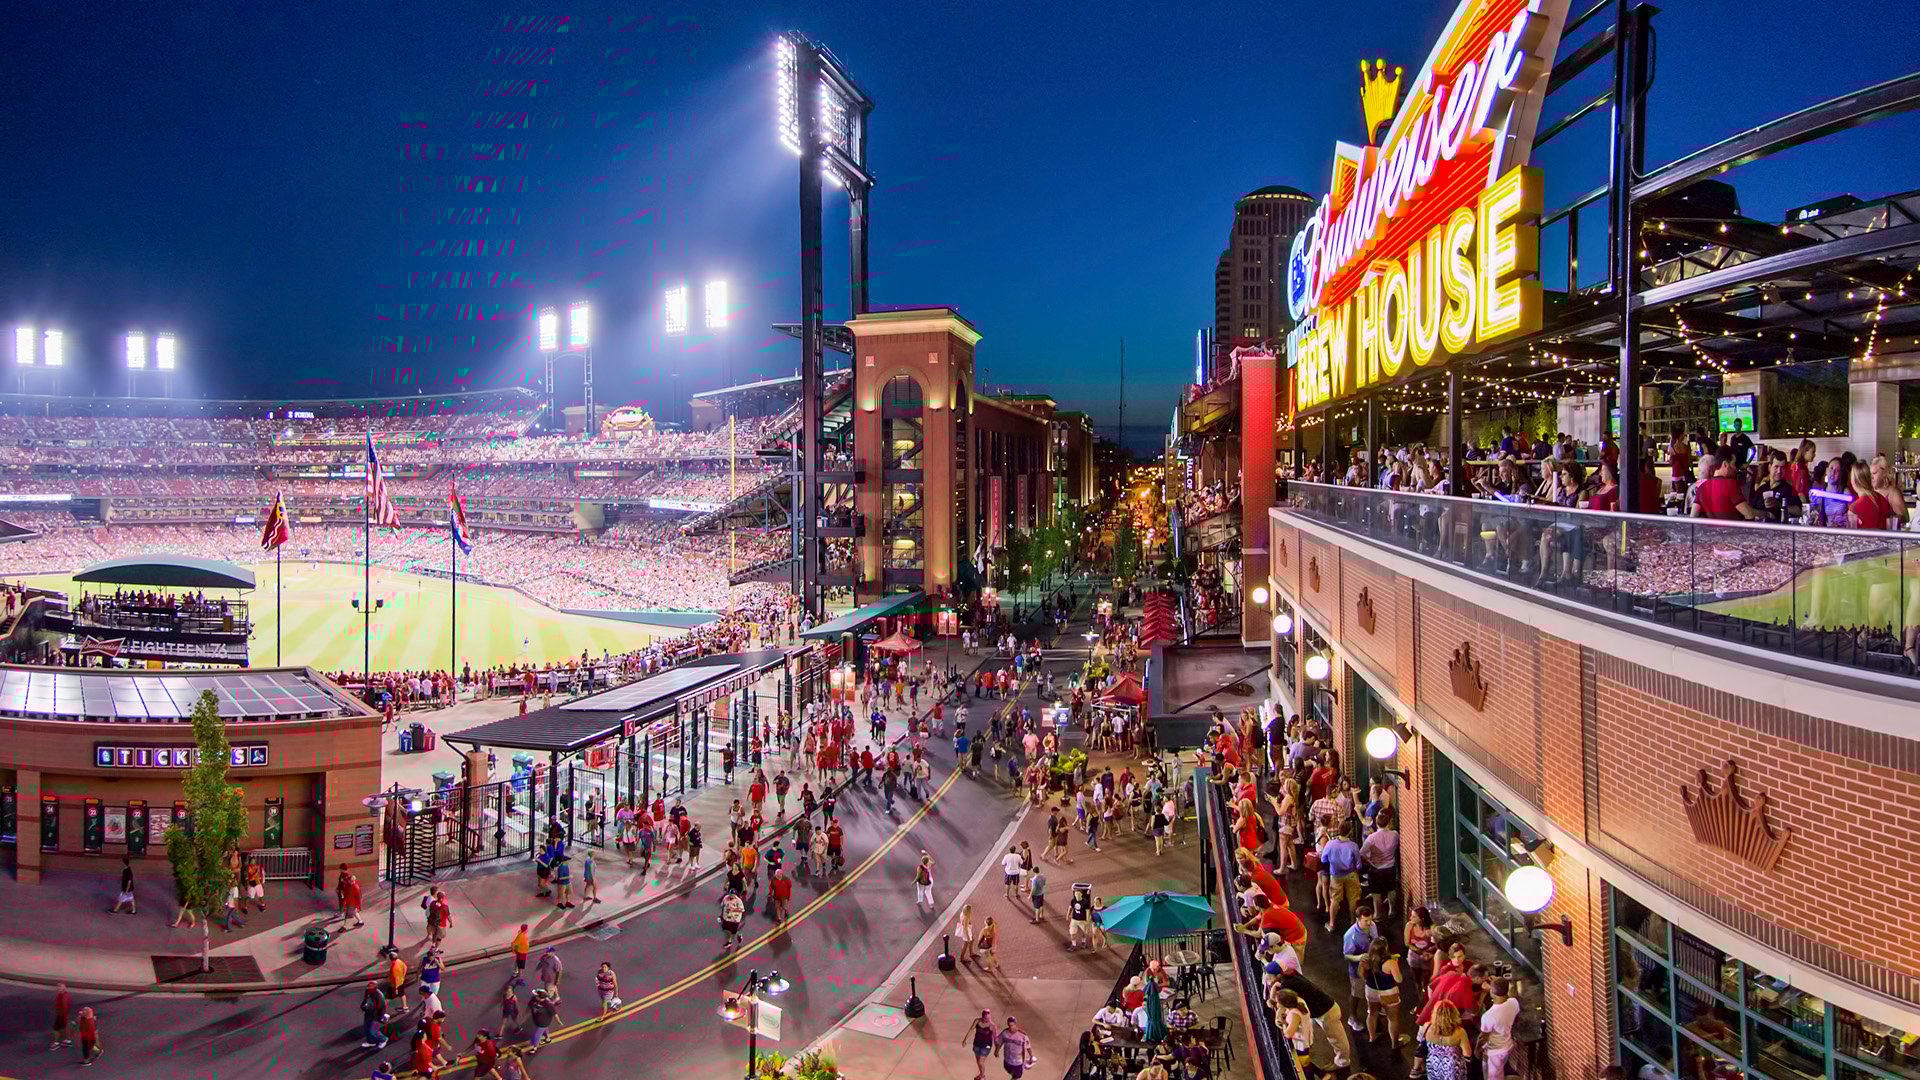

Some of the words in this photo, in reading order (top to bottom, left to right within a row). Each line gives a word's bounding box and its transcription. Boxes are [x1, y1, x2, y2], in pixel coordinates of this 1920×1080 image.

[1302, 9, 1533, 316] Budweiser
[1297, 298, 1351, 413] BREW
[1357, 166, 1522, 389] HOUSE
[132, 640, 206, 657] EIGHTEEN
[682, 684, 727, 715] CENTER
[729, 670, 761, 692] FIELD
[628, 722, 634, 734] 5
[120, 749, 245, 766] TICKS
